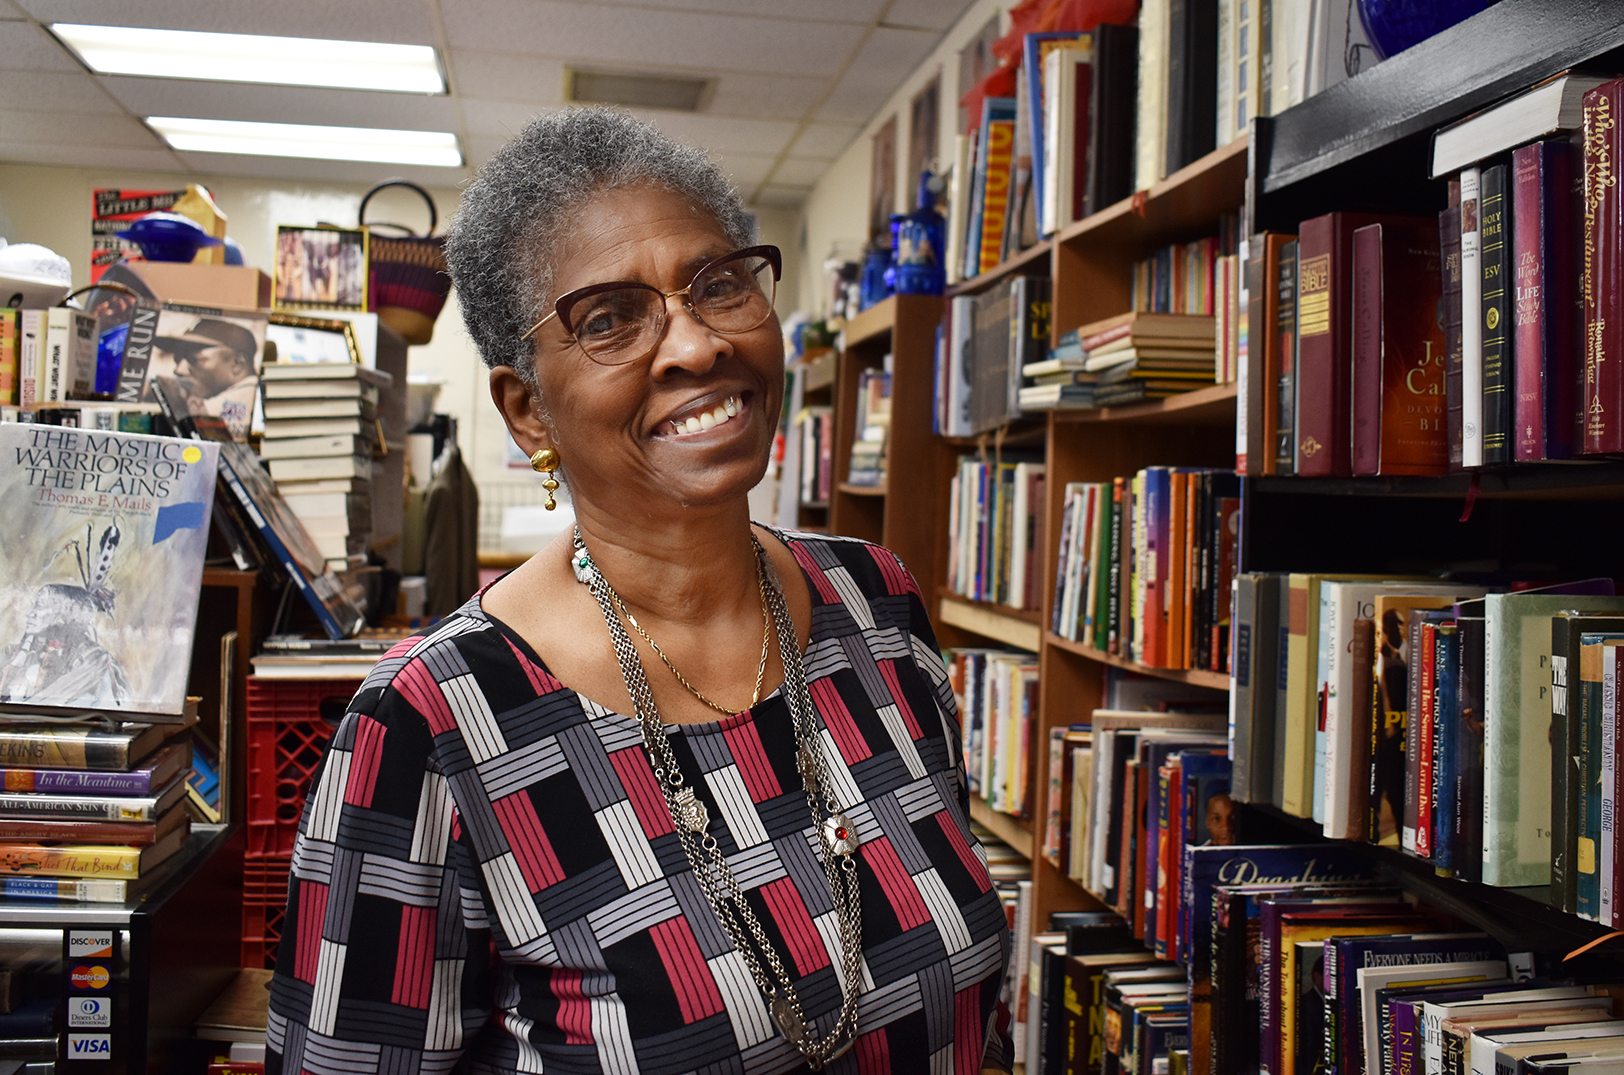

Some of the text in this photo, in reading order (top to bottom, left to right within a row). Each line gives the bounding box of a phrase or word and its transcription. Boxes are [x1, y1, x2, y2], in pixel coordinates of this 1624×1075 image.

[1595, 96, 1616, 201] Who's Who
[1482, 211, 1502, 226] HOLY
[1482, 223, 1502, 238] BIBLE
[1520, 251, 1536, 266] The
[1584, 199, 1598, 308] Testament
[1484, 263, 1501, 279] ESV
[1517, 262, 1539, 280] Word
[1300, 274, 1327, 294] BIBLE
[1516, 286, 1540, 301] LIFE
[1516, 298, 1541, 314] Study
[1517, 311, 1539, 326] Bible
[127, 308, 157, 360] RUN
[1594, 318, 1605, 362] Ronald
[1418, 340, 1445, 367] Je
[1406, 367, 1447, 396] Cal
[28, 429, 181, 462] THE MYSTIC
[15, 447, 187, 481] WARRIORS OF
[25, 467, 170, 499] THE PLAINS
[38, 488, 94, 506] Thomas
[112, 495, 152, 511] Mails
[1552, 655, 1567, 686] THE
[1410, 680, 1417, 693] OF
[1421, 689, 1431, 712] HOLY
[1433, 687, 1441, 728] CHRIST
[1552, 685, 1567, 716] WAY
[1408, 696, 1417, 762] MUHAMMAD
[1420, 713, 1430, 742] SPIRIT
[1602, 673, 1614, 771] CLASSIC CHRISTIANITY
[1432, 732, 1440, 756] THE
[39, 773, 132, 788] In the Meantime
[1419, 762, 1429, 794] LATTER
[1431, 759, 1440, 809] HEALER
[1, 800, 99, 811] ALL-AMERICAN SKIN
[1418, 794, 1428, 817] DAYS
[1602, 798, 1613, 832] GEORGE
[41, 856, 123, 874] Ties That Bind
[71, 938, 111, 946] DISCOVER
[1363, 950, 1411, 968] EVERYONE
[1413, 952, 1443, 965] NEEDS
[1453, 951, 1490, 963] MIRACLE
[71, 973, 109, 982] MasterCard
[1262, 938, 1271, 1030] THE WONDERFUL
[1280, 950, 1288, 1028] The Truth about
[71, 1013, 108, 1021] Diners Club
[1425, 1012, 1442, 1030] MY
[71, 1040, 110, 1053] VISA
[1400, 1031, 1413, 1046] IN
[1425, 1030, 1442, 1047] LIFE
